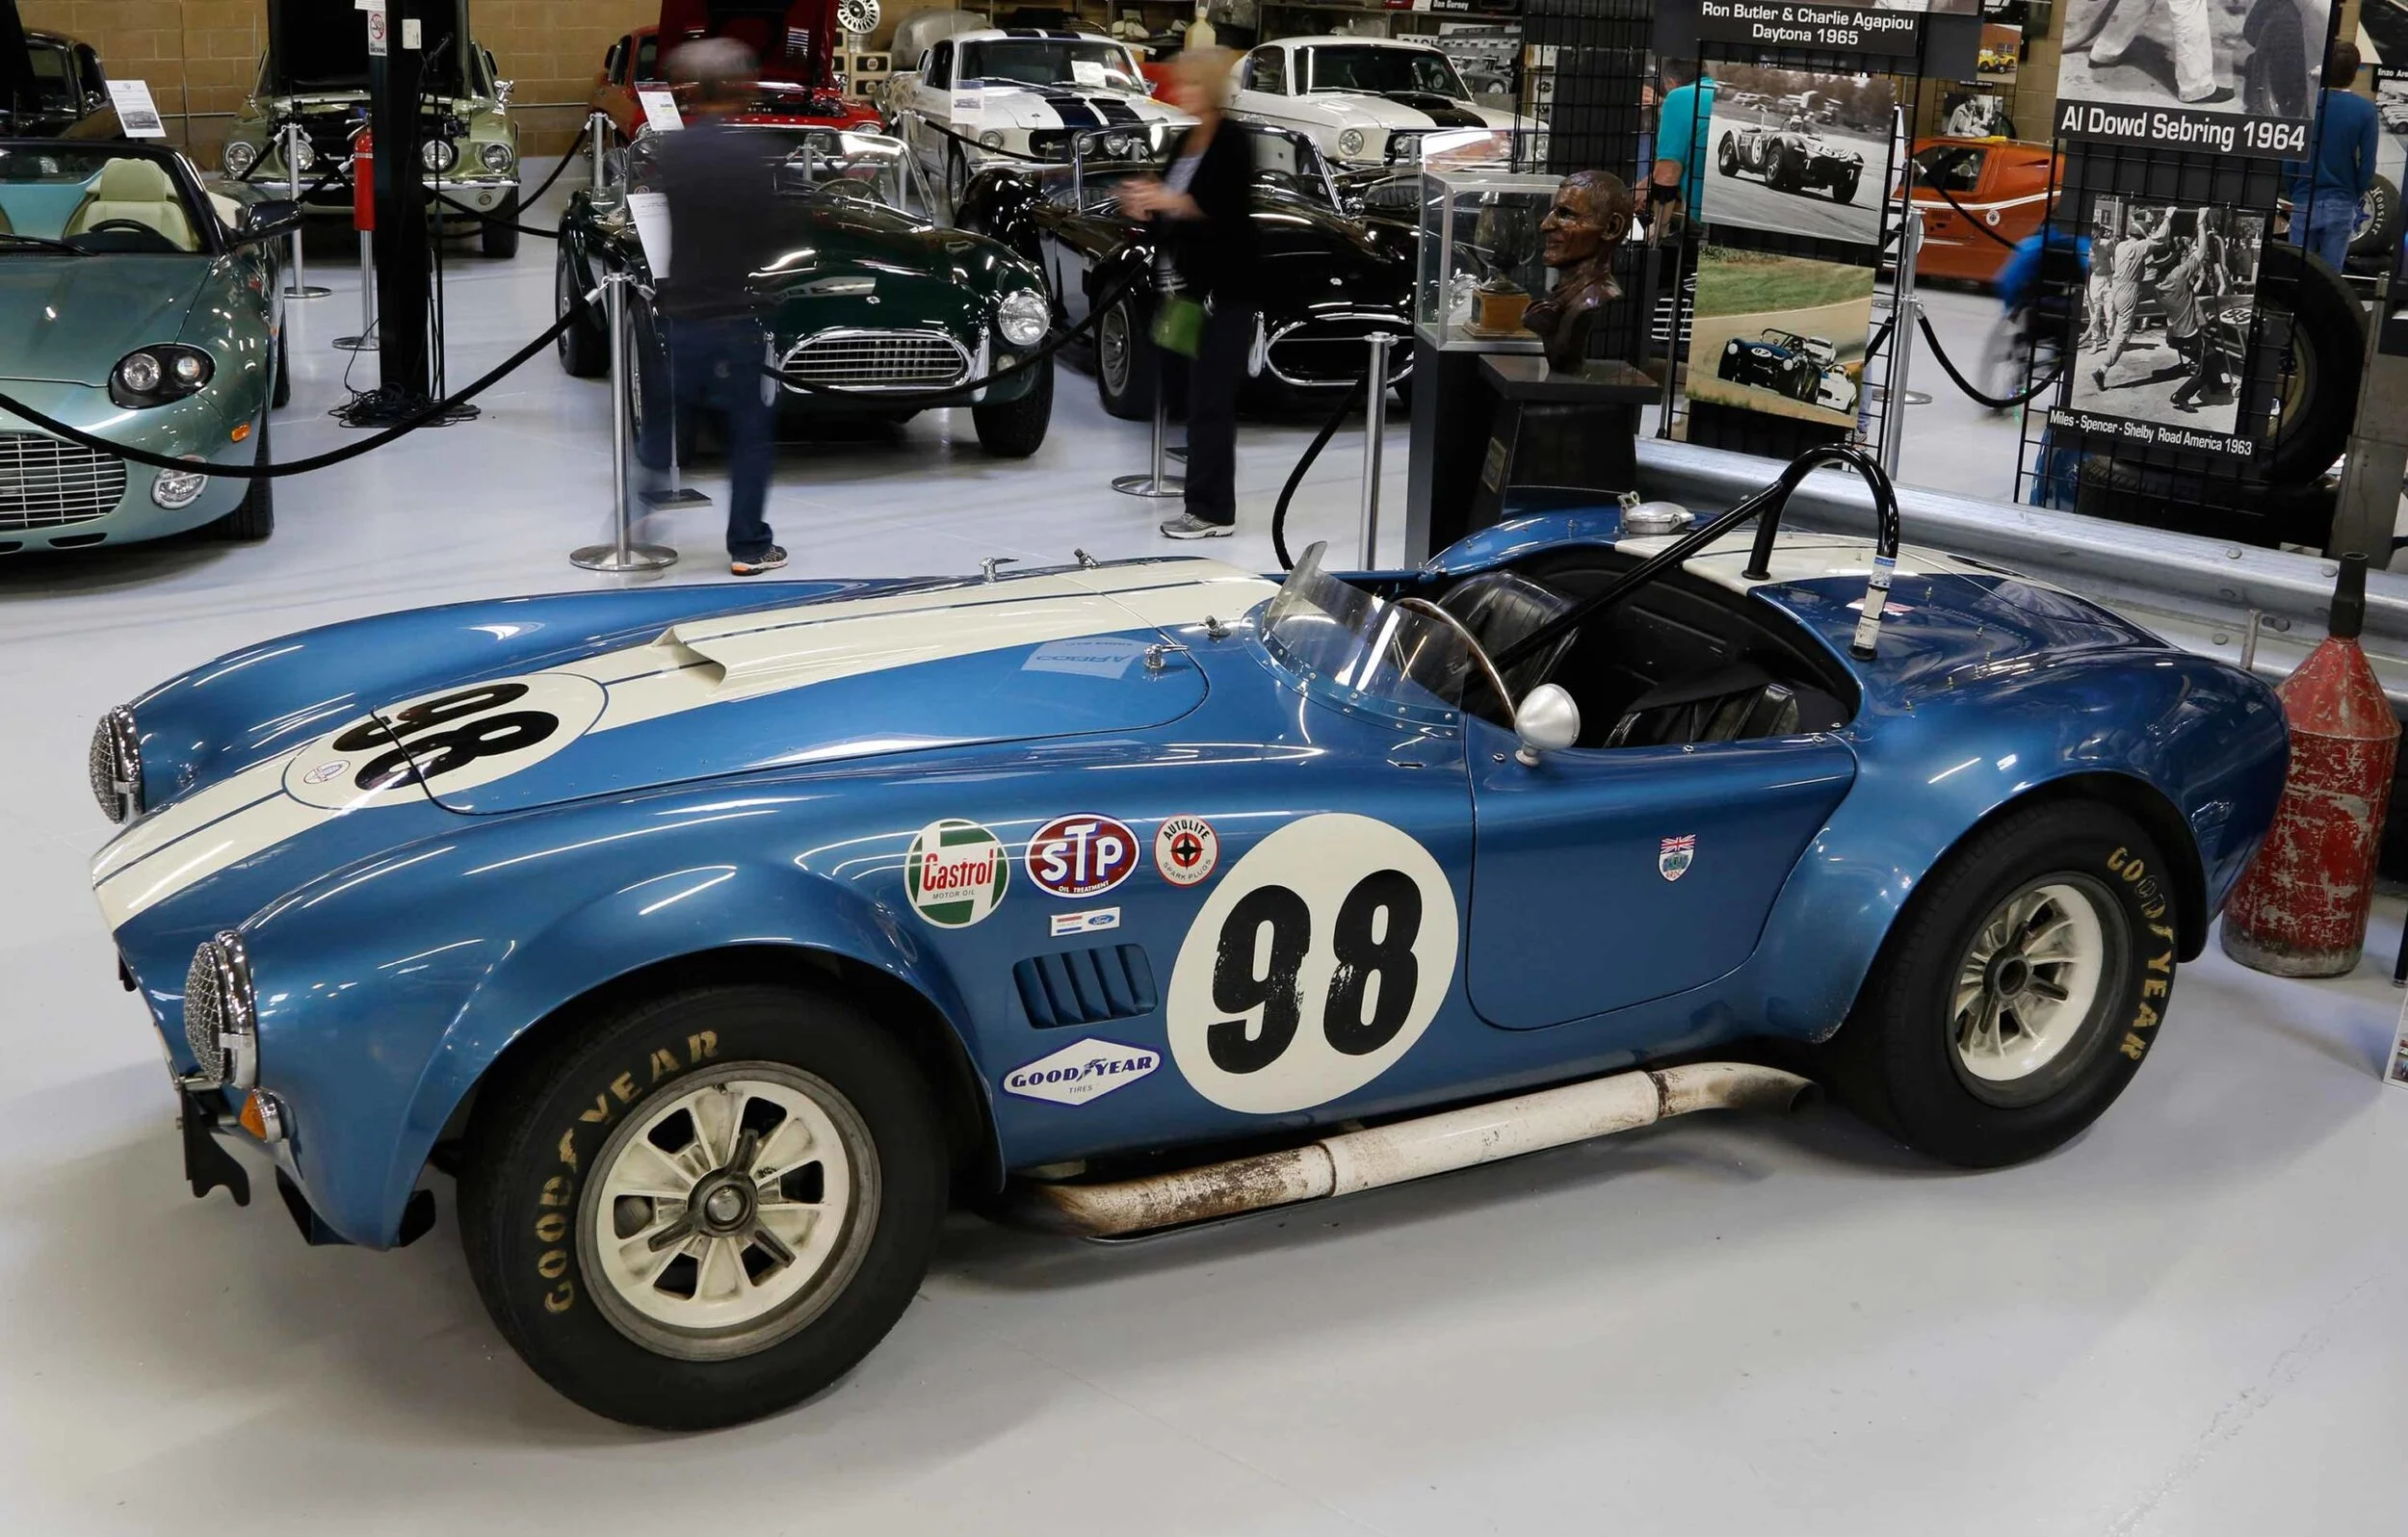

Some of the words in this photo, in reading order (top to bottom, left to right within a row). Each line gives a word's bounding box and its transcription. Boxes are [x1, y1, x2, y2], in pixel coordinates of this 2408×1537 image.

[1702, 2, 1730, 17] Ron
[1734, 4, 1778, 21] Butler
[1782, 8, 1793, 22] &
[1797, 10, 1848, 25] Charlie
[1852, 13, 1914, 32] Agapiou
[1752, 23, 1812, 42] Daytona
[1817, 29, 1859, 45] 1965
[2377, 67, 2395, 77] Enzo
[2061, 105, 2083, 131] Al
[2087, 108, 2147, 137] Dowd
[2152, 113, 2235, 152] Sebring
[2243, 121, 2306, 151] 1964
[2369, 186, 2386, 236] Hoosier
[2050, 410, 2074, 427] Miles
[2081, 415, 2118, 432] Spencer
[2124, 422, 2155, 443] Shelby
[2158, 427, 2182, 444] Road
[2183, 431, 2222, 451] America
[2225, 438, 2253, 456] 1963
[332, 683, 560, 790] 98
[1163, 819, 1211, 841] AUTOLITE
[1039, 822, 1123, 881] STP
[923, 848, 994, 892] Castrol
[1163, 861, 1187, 880] SPARK
[1188, 858, 1213, 880] PLUGS
[932, 890, 960, 900] MOTOR
[962, 889, 976, 898] OIL
[1059, 885, 1070, 894] OIL
[1073, 880, 1110, 894] TREATMENT
[1207, 869, 1423, 1074] 98
[1069, 1084, 1093, 1094] TIRES
